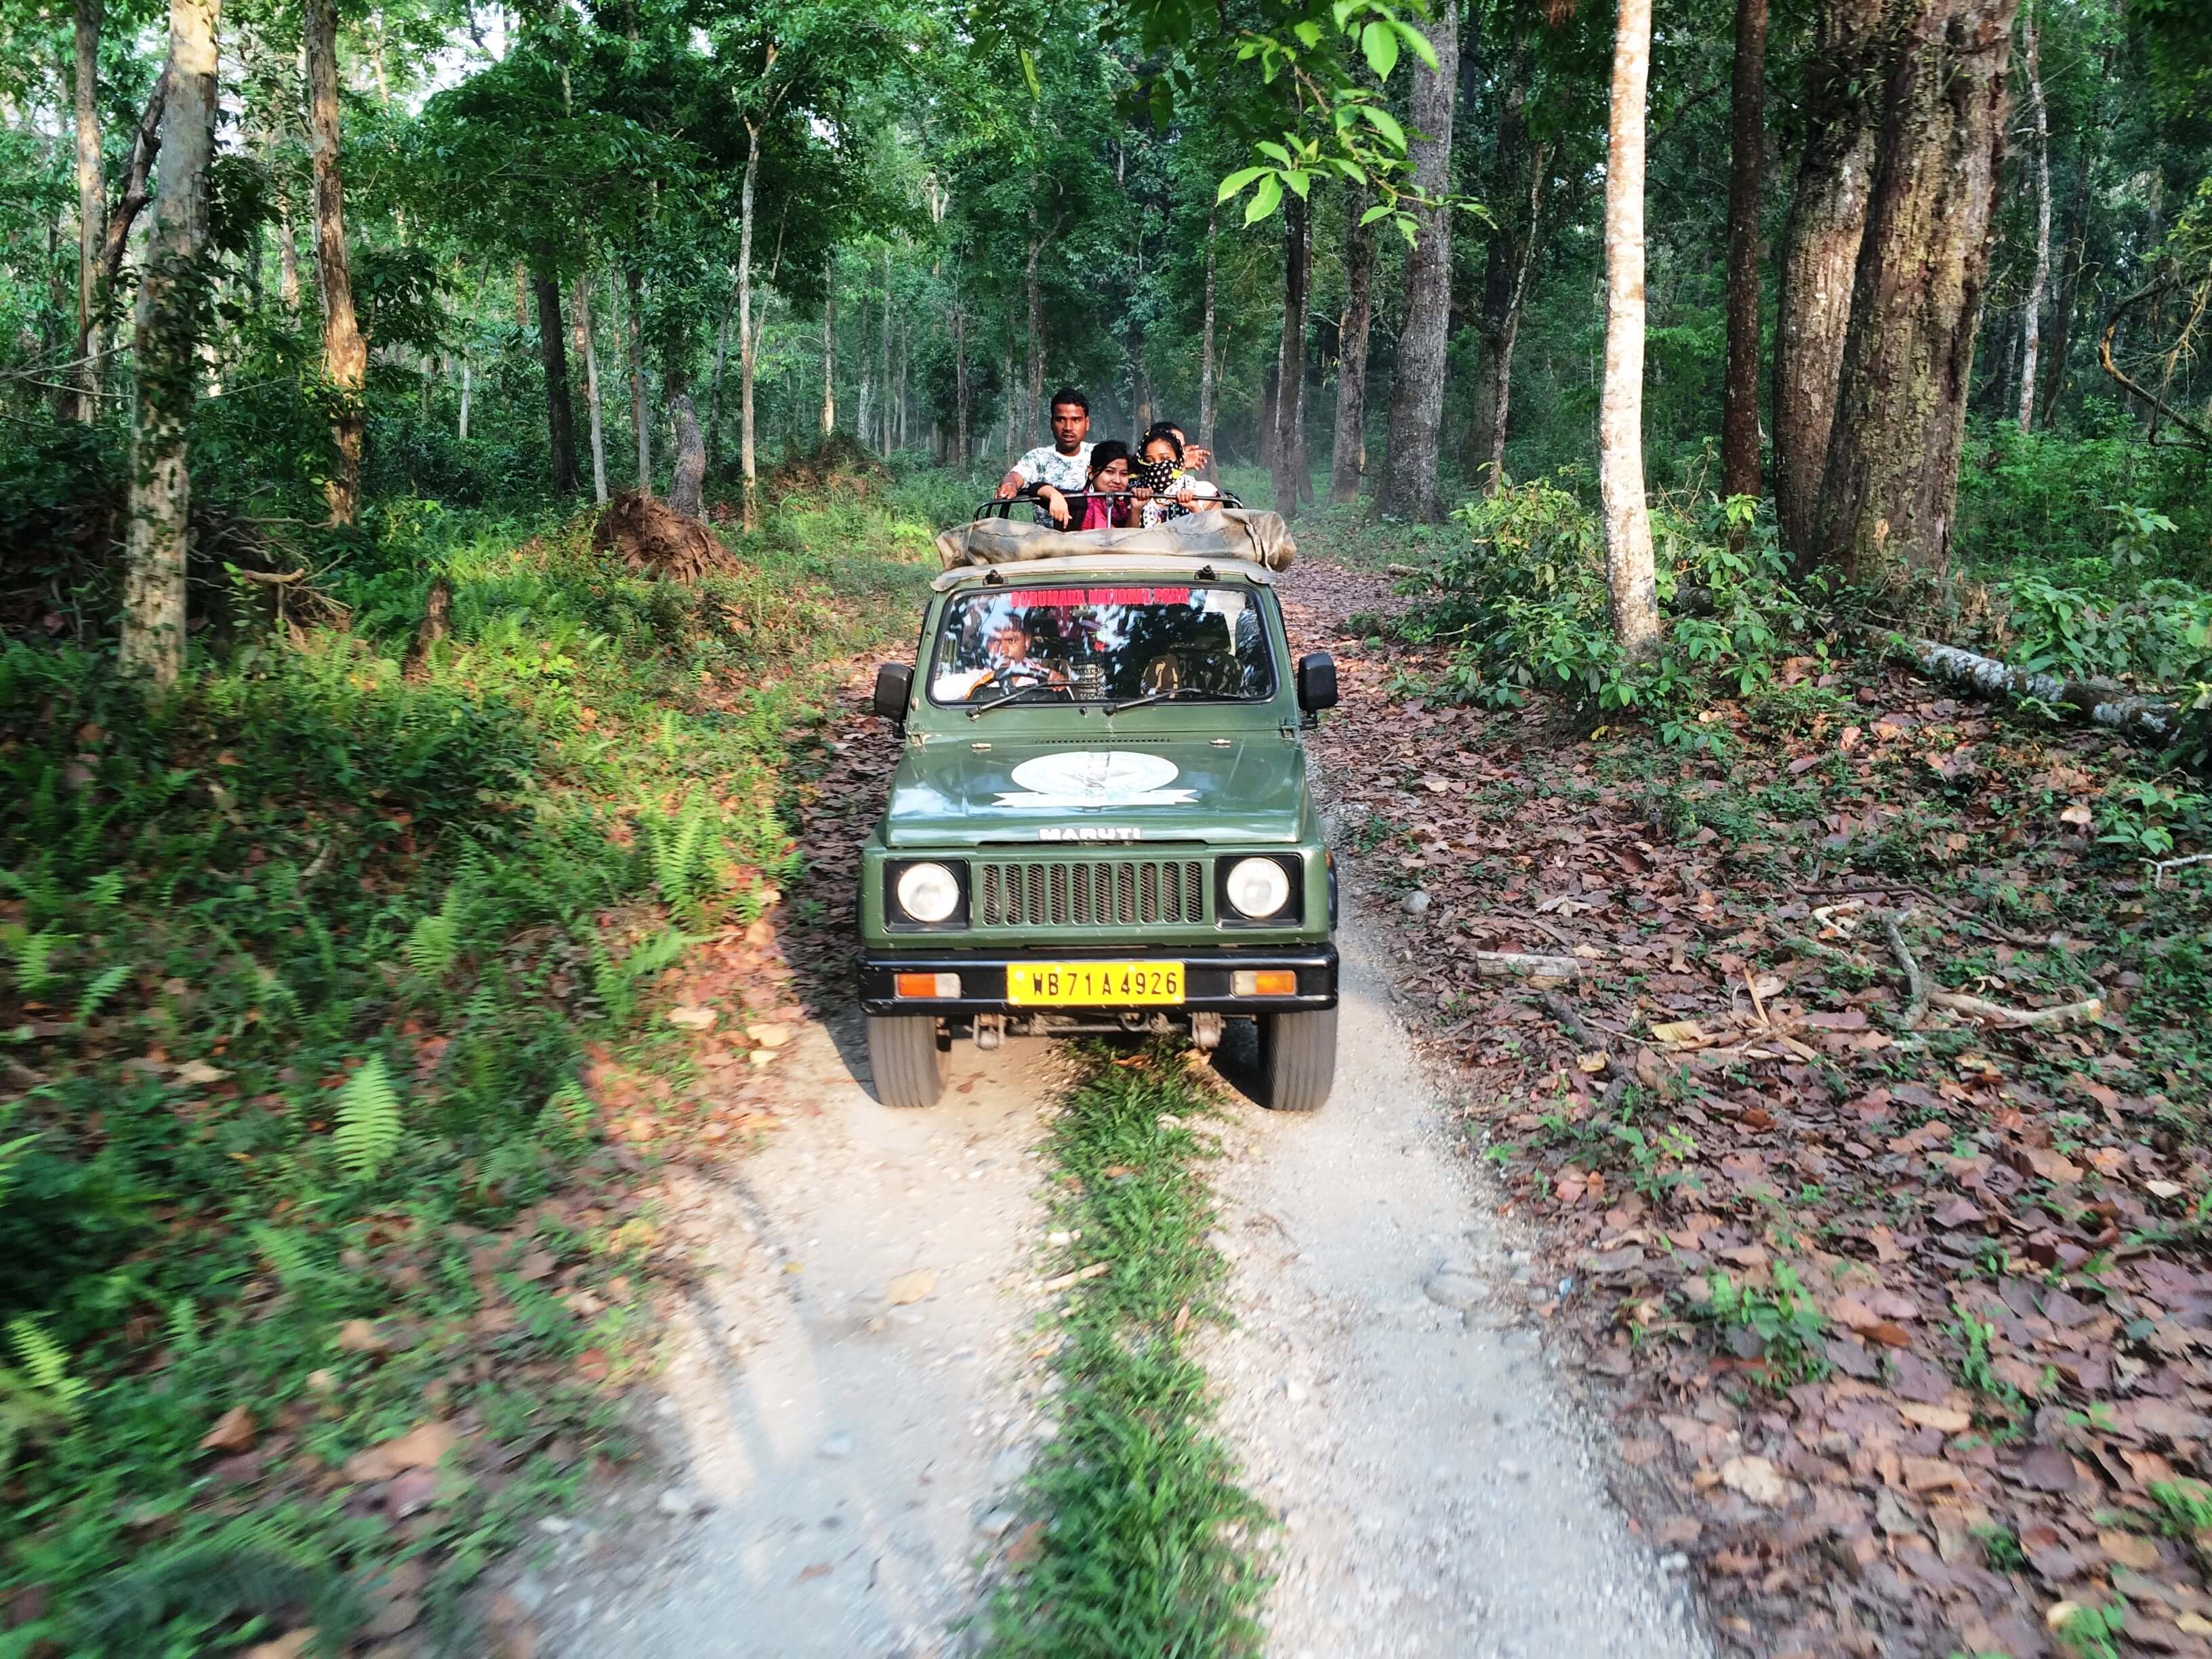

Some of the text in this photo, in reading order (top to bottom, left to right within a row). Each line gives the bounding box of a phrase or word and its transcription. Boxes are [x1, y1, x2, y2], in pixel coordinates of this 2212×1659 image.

[1088, 588, 1151, 605] NATIONAL
[1153, 588, 1189, 604] PARK
[1039, 827, 1141, 840] MARUTI
